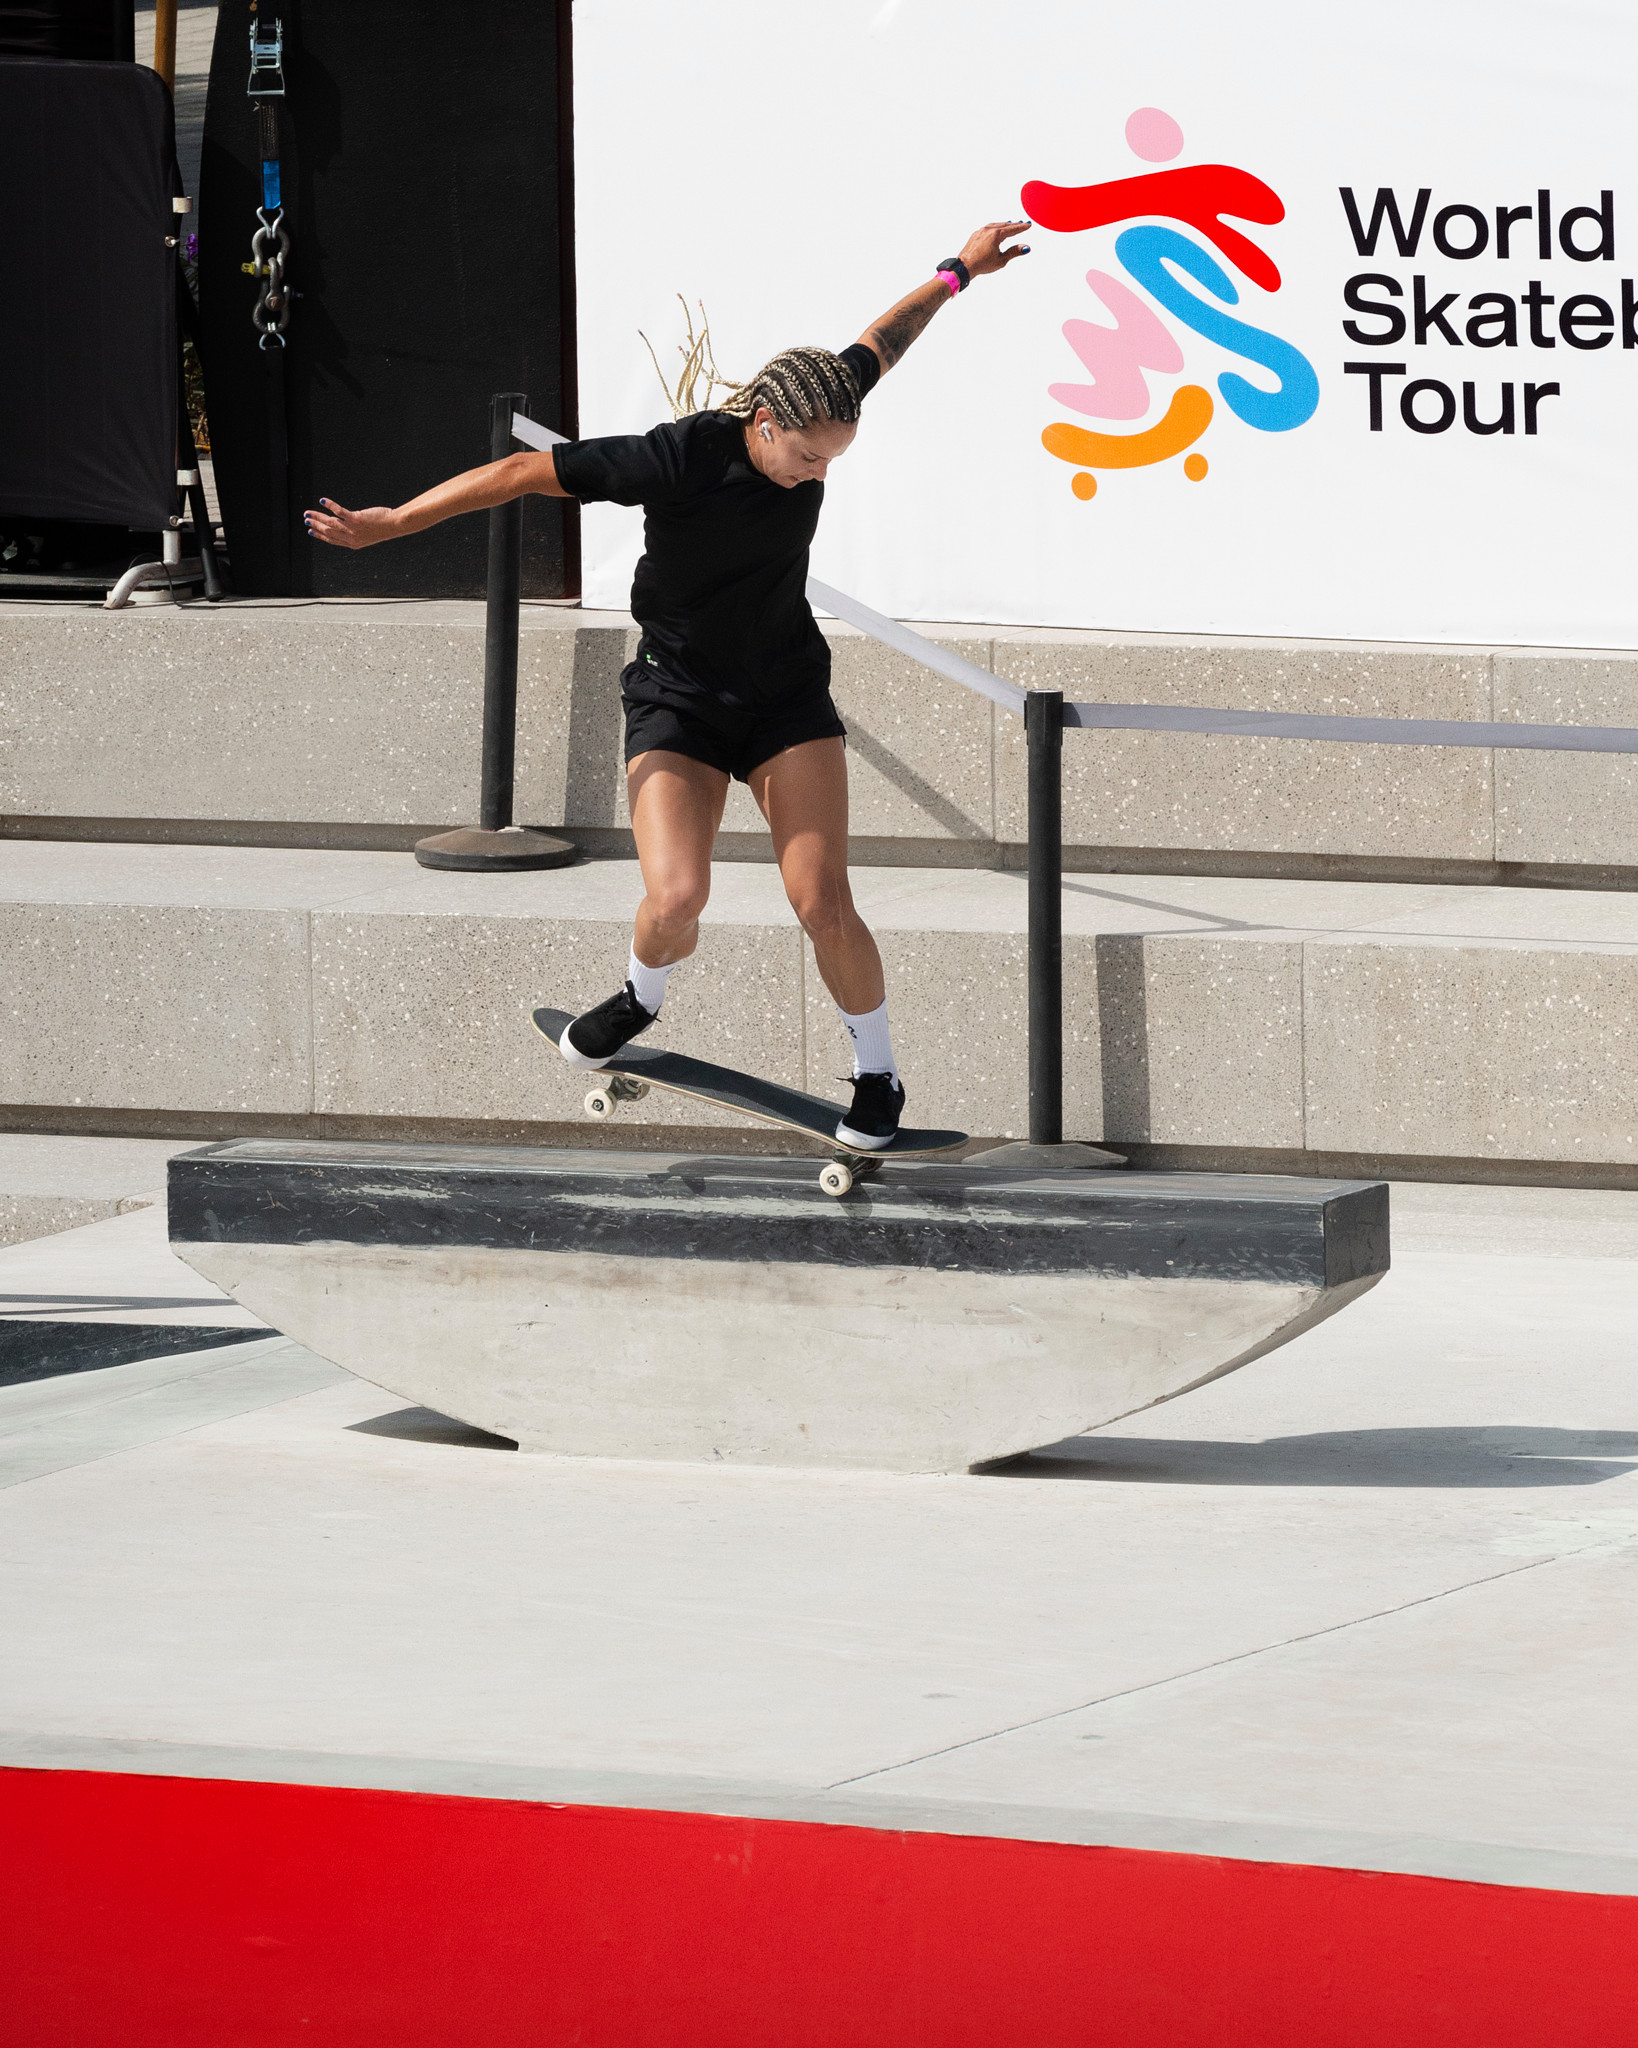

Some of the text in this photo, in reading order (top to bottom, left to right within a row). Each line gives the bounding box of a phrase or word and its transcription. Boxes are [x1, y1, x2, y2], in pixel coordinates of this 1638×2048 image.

[1339, 187, 1615, 262] World
[1342, 273, 1638, 350] Skate
[1343, 361, 1561, 436] Tour
